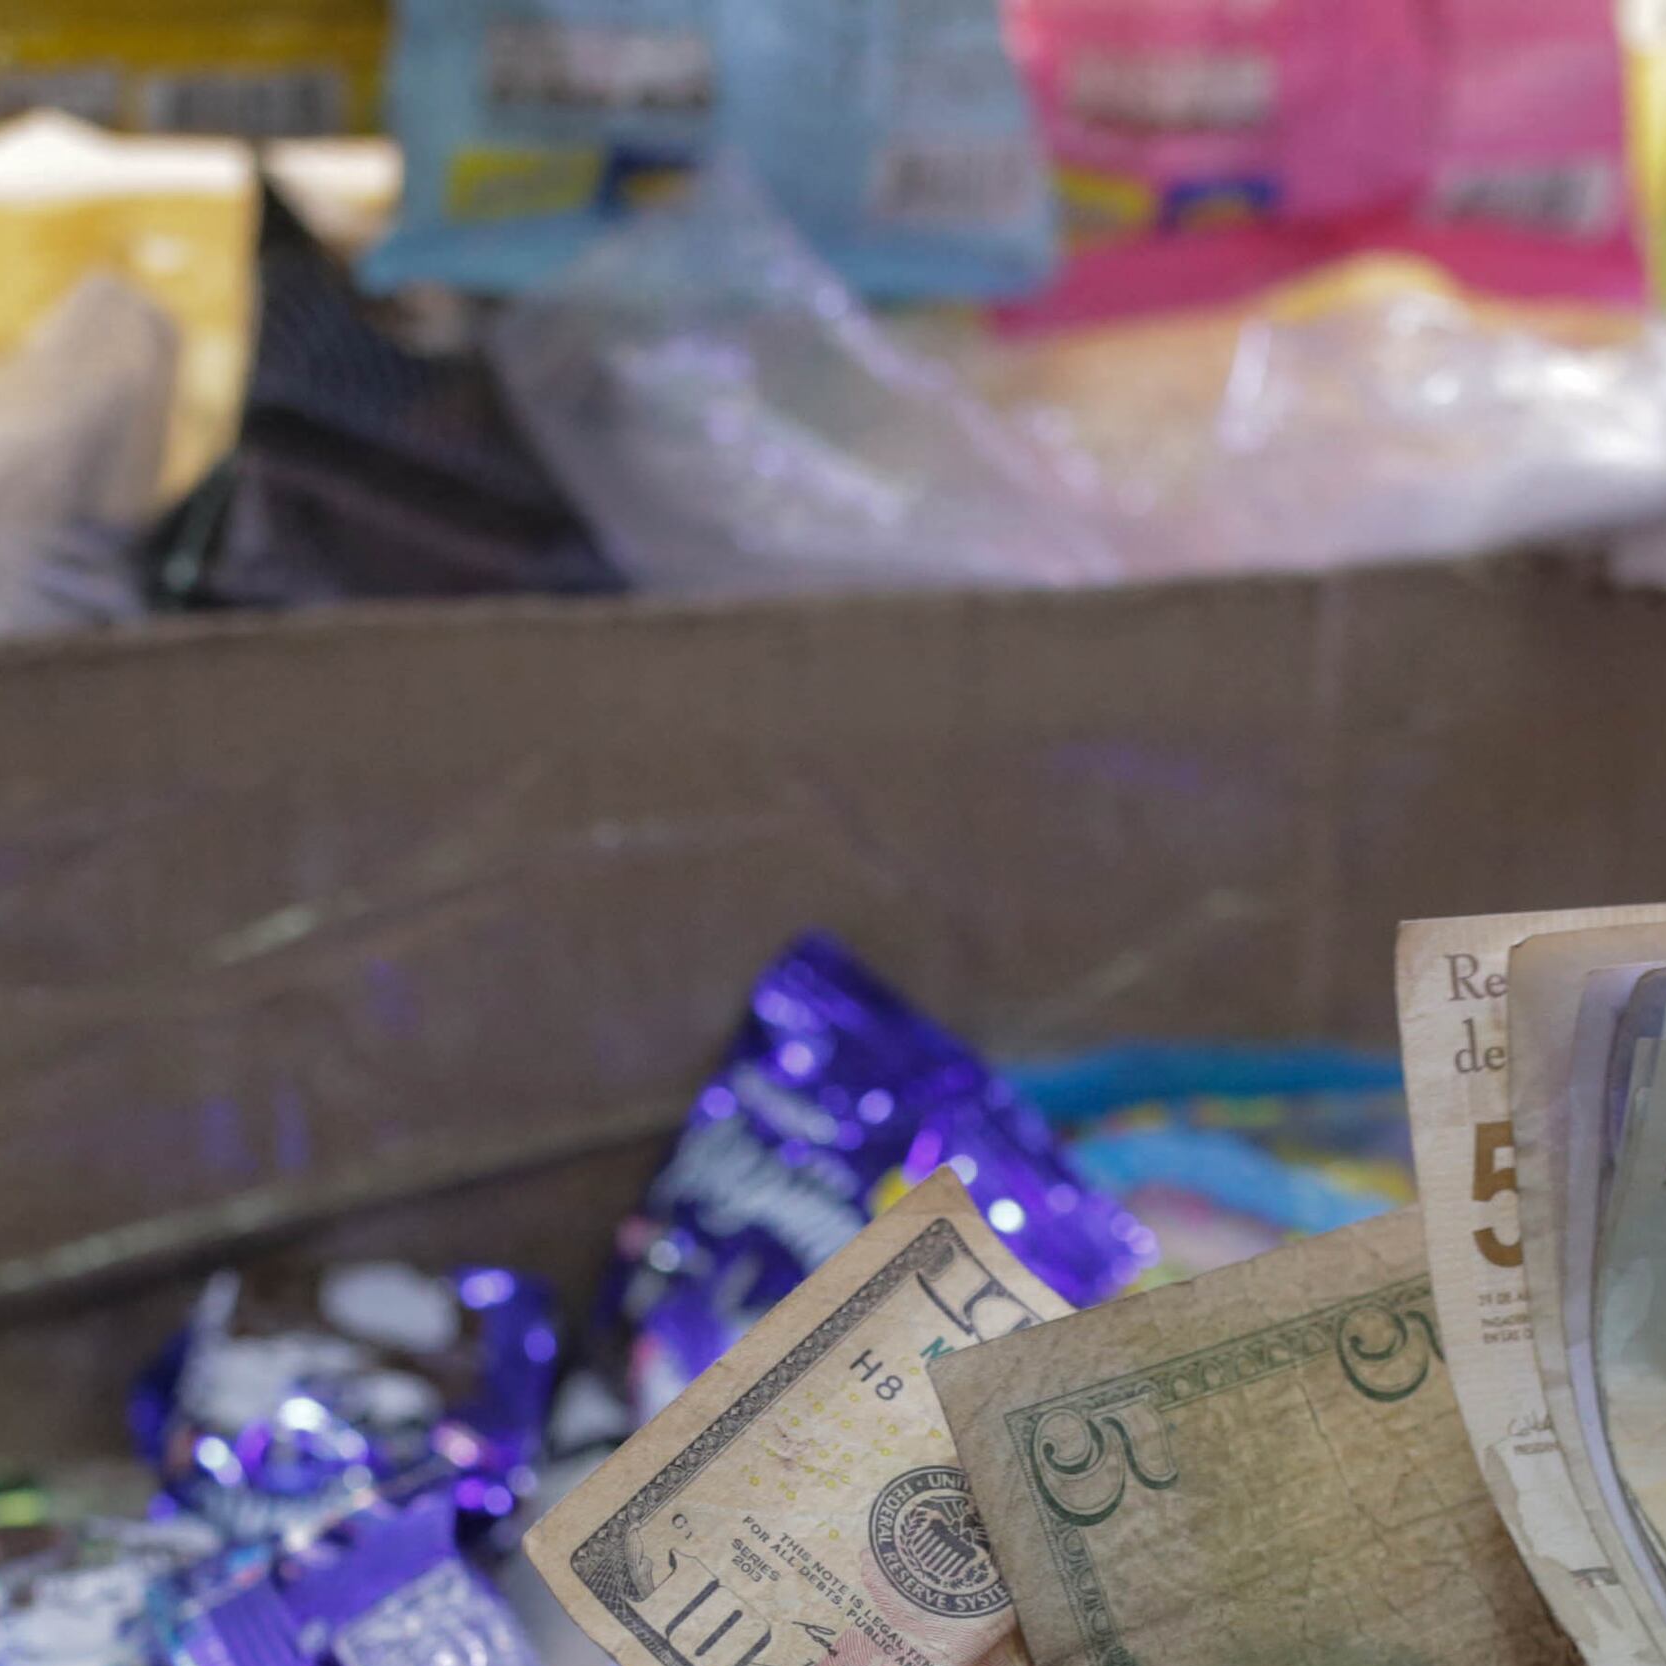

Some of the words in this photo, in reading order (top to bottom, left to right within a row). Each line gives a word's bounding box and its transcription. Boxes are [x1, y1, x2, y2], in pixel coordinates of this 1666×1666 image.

[1033, 1384, 1179, 1527] 5
[876, 1481, 915, 1545] FEDERAL
[731, 1537, 781, 1583] SERIES
[731, 1555, 763, 1584] 2013
[742, 1515, 772, 1545] FOR
[770, 1540, 797, 1569] ALL
[845, 1609, 897, 1658] PUBLIC
[778, 1532, 813, 1565] THIS
[813, 1560, 850, 1595] NOTE
[849, 1593, 865, 1611] IS
[863, 1609, 905, 1649] LEGAL
[883, 1551, 947, 1609] RESERVE
[955, 1583, 1010, 1611] SYSTE
